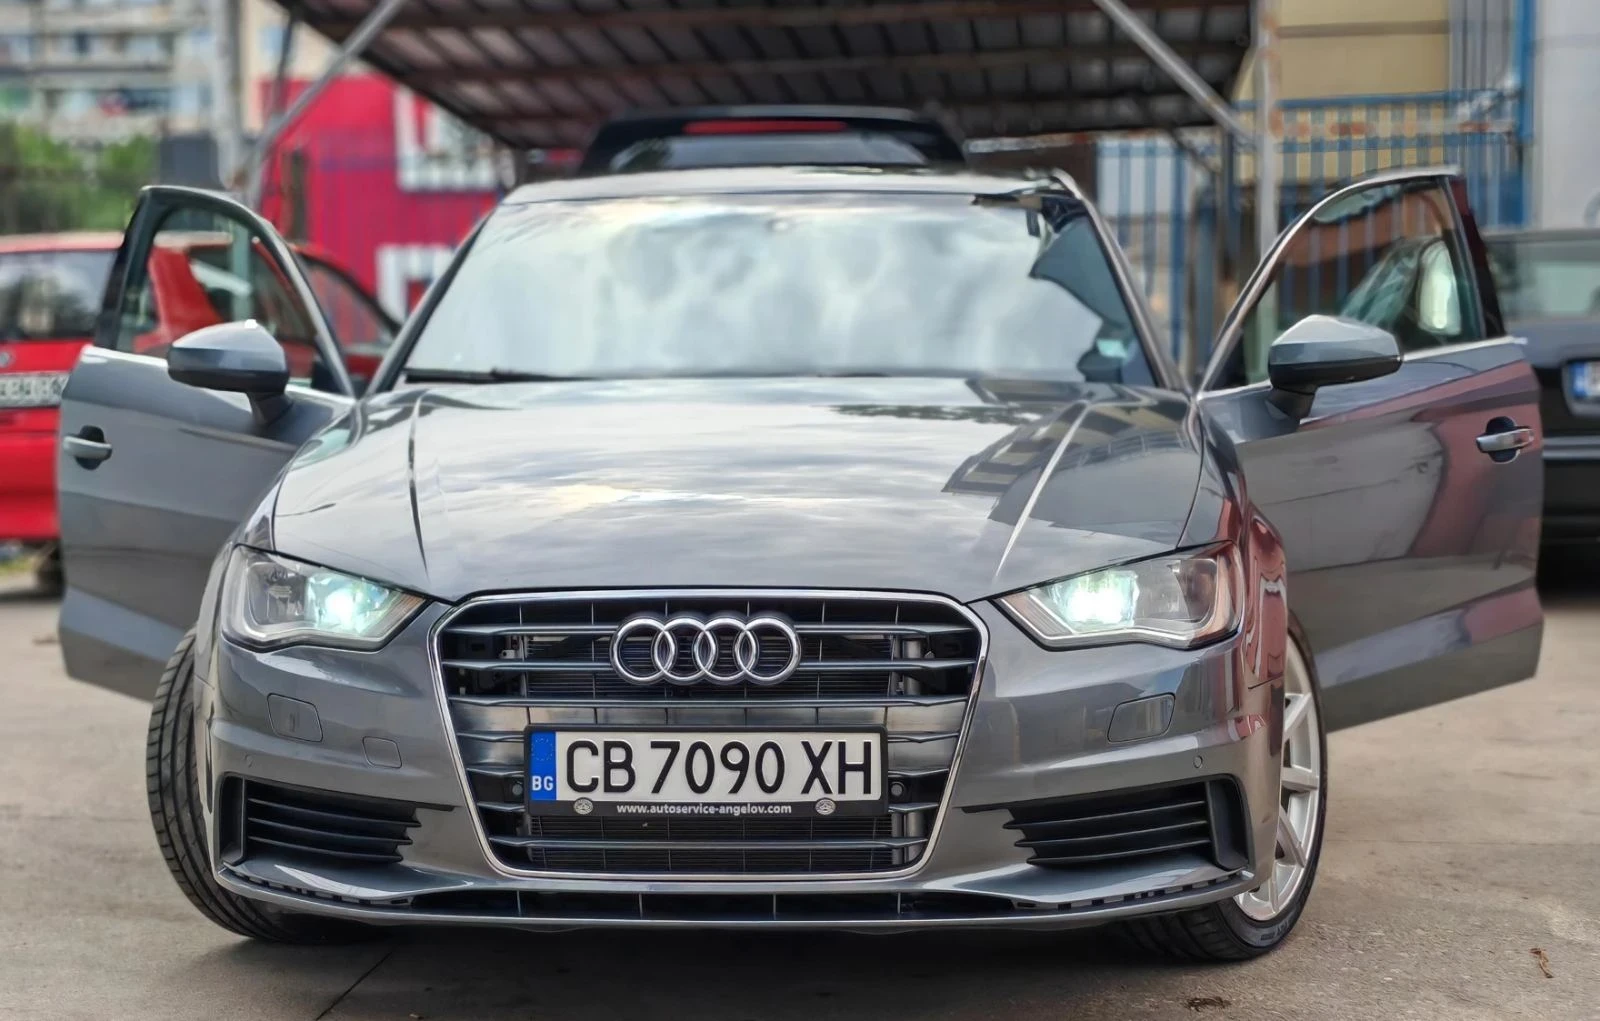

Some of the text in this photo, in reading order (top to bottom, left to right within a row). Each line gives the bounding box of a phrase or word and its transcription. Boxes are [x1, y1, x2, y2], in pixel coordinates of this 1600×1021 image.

[566, 740, 872, 795] CB 7090 XH
[531, 775, 554, 791] BG
[616, 803, 792, 816] www.autoservice-angelov.com
